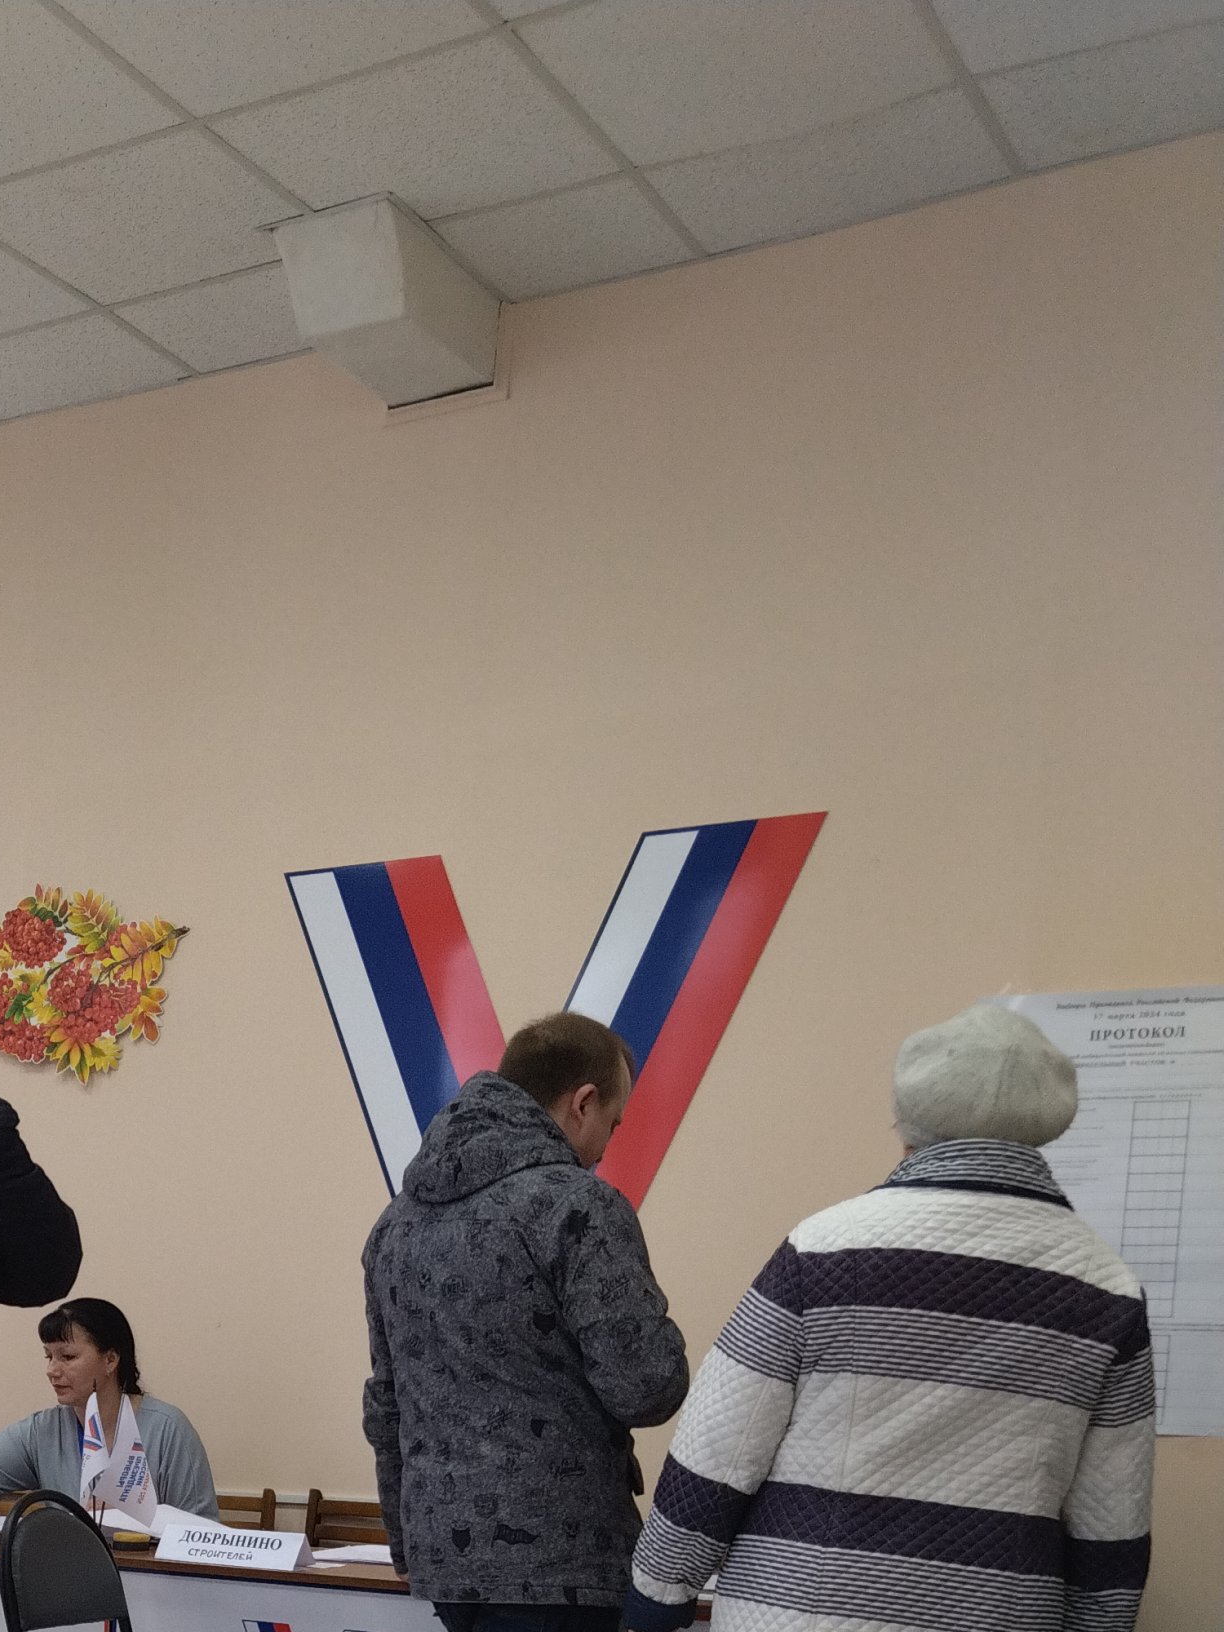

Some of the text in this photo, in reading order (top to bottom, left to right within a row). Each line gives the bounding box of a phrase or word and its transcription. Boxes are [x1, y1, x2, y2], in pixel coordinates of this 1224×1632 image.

[1089, 1026, 1186, 1041] ПРОТОКОЛ
[179, 1530, 282, 1550] ДОБРЫНИНО
[187, 1548, 253, 1561] СТРОИТЕЛЕЙ
